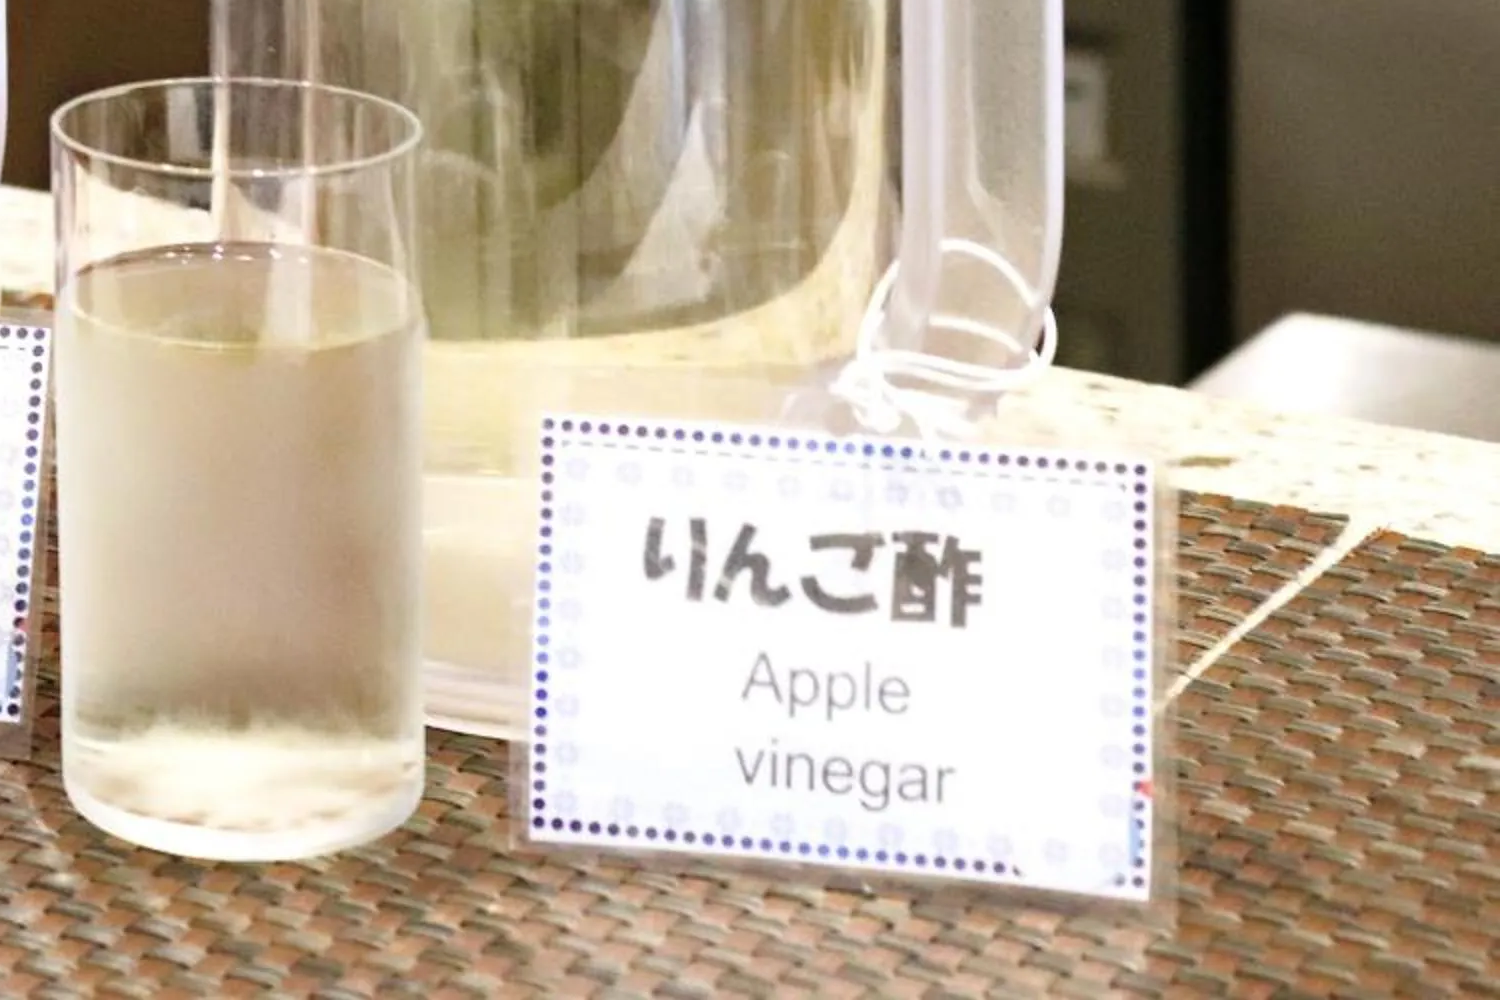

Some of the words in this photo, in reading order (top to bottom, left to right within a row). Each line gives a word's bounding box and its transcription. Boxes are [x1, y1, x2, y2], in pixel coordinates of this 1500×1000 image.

[643, 516, 983, 628] りんご酢
[740, 650, 912, 721] Apple
[735, 738, 956, 812] vinegar
